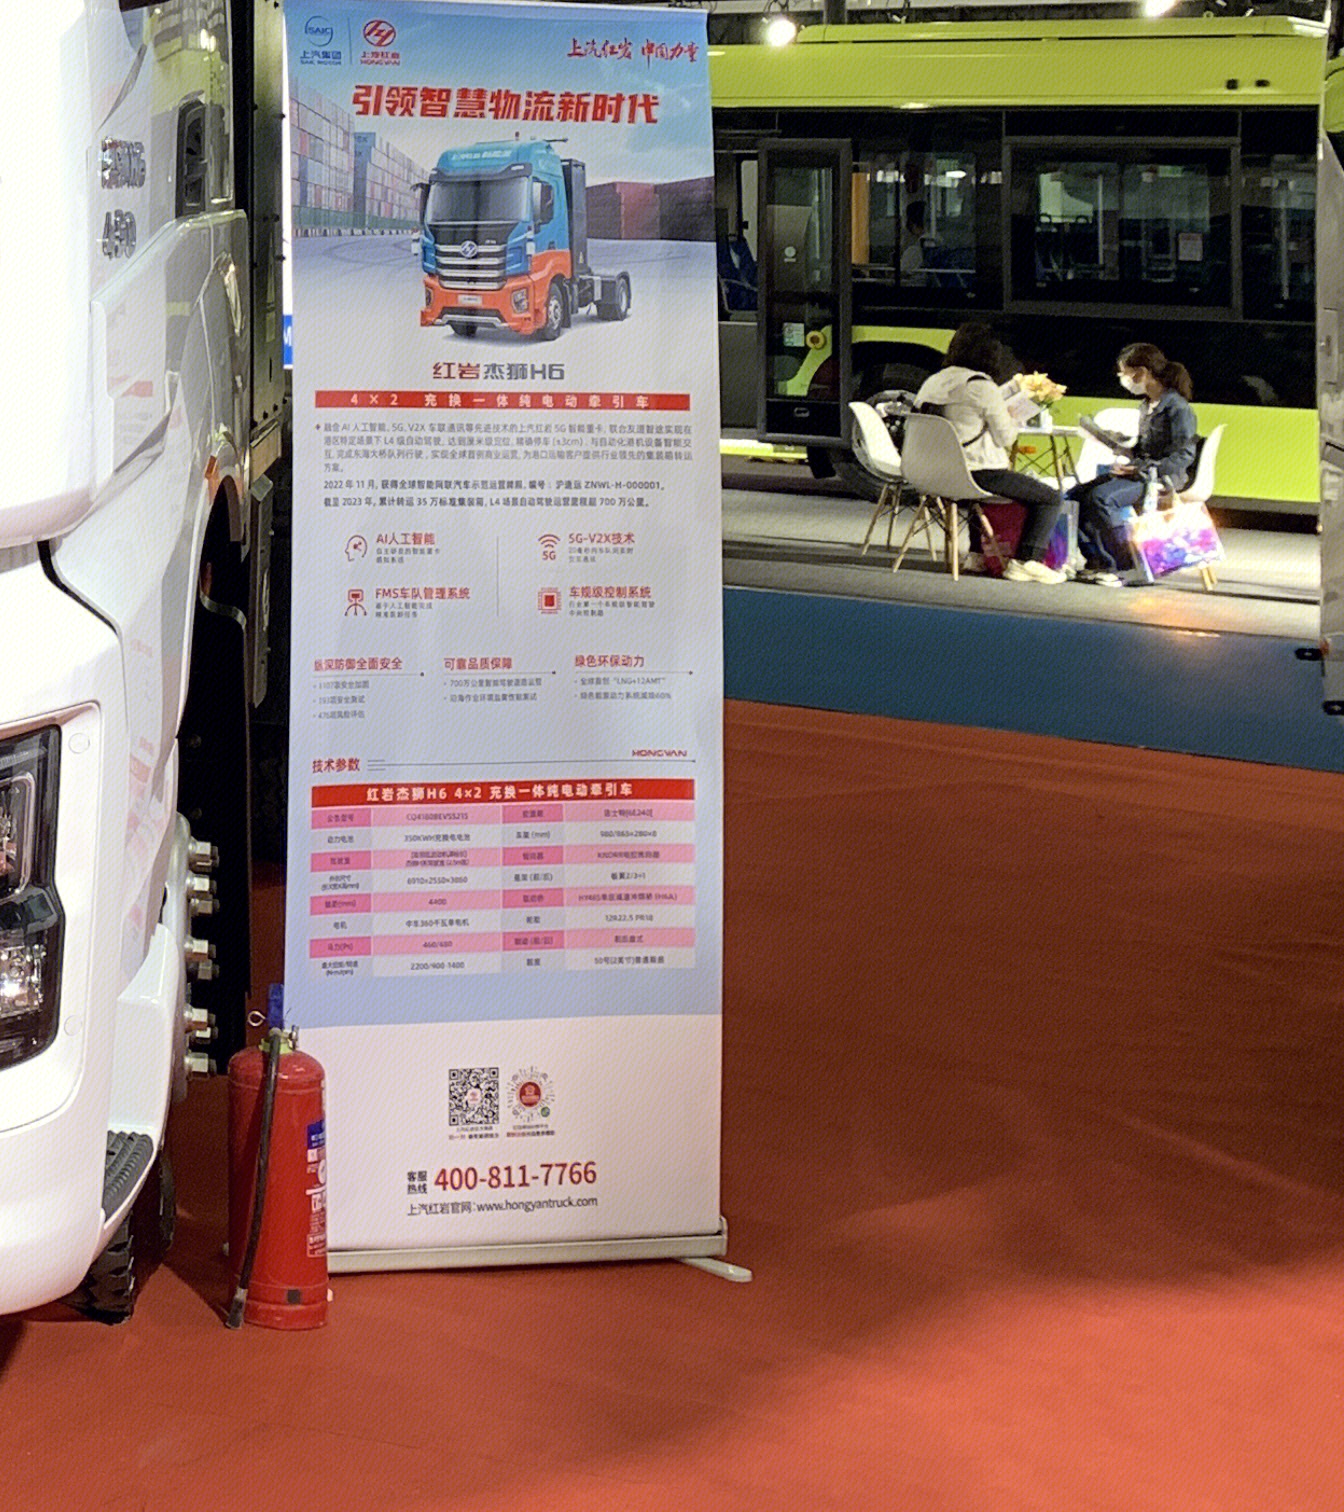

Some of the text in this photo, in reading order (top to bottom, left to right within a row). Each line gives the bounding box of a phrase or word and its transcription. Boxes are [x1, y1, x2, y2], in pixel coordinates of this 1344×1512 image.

[300, 50, 341, 59] 上汽集团
[352, 85, 659, 124] 引领智慧物流新时代
[433, 361, 565, 381] 红岩杰狮H6
[424, 393, 649, 408] 充换一体纯电动牵引车
[376, 533, 435, 545] AI人工智能
[568, 532, 635, 544] 5G-V2X技术
[542, 551, 556, 560] 5G
[375, 587, 470, 600] FMS车队管理系统
[569, 586, 652, 599] 车规级控制系统
[443, 656, 512, 670] 可靠品质保障
[574, 654, 645, 668] 绿色环保动力
[631, 749, 688, 757] HONGYAN
[312, 758, 360, 774] 技术参数
[366, 787, 447, 802] 红岩杰狮H6
[489, 782, 633, 800] 充换一体纯电动牵引车
[407, 1170, 428, 1182] 客服
[434, 1161, 597, 1191] 400-811-7766
[407, 1183, 428, 1195] 热线
